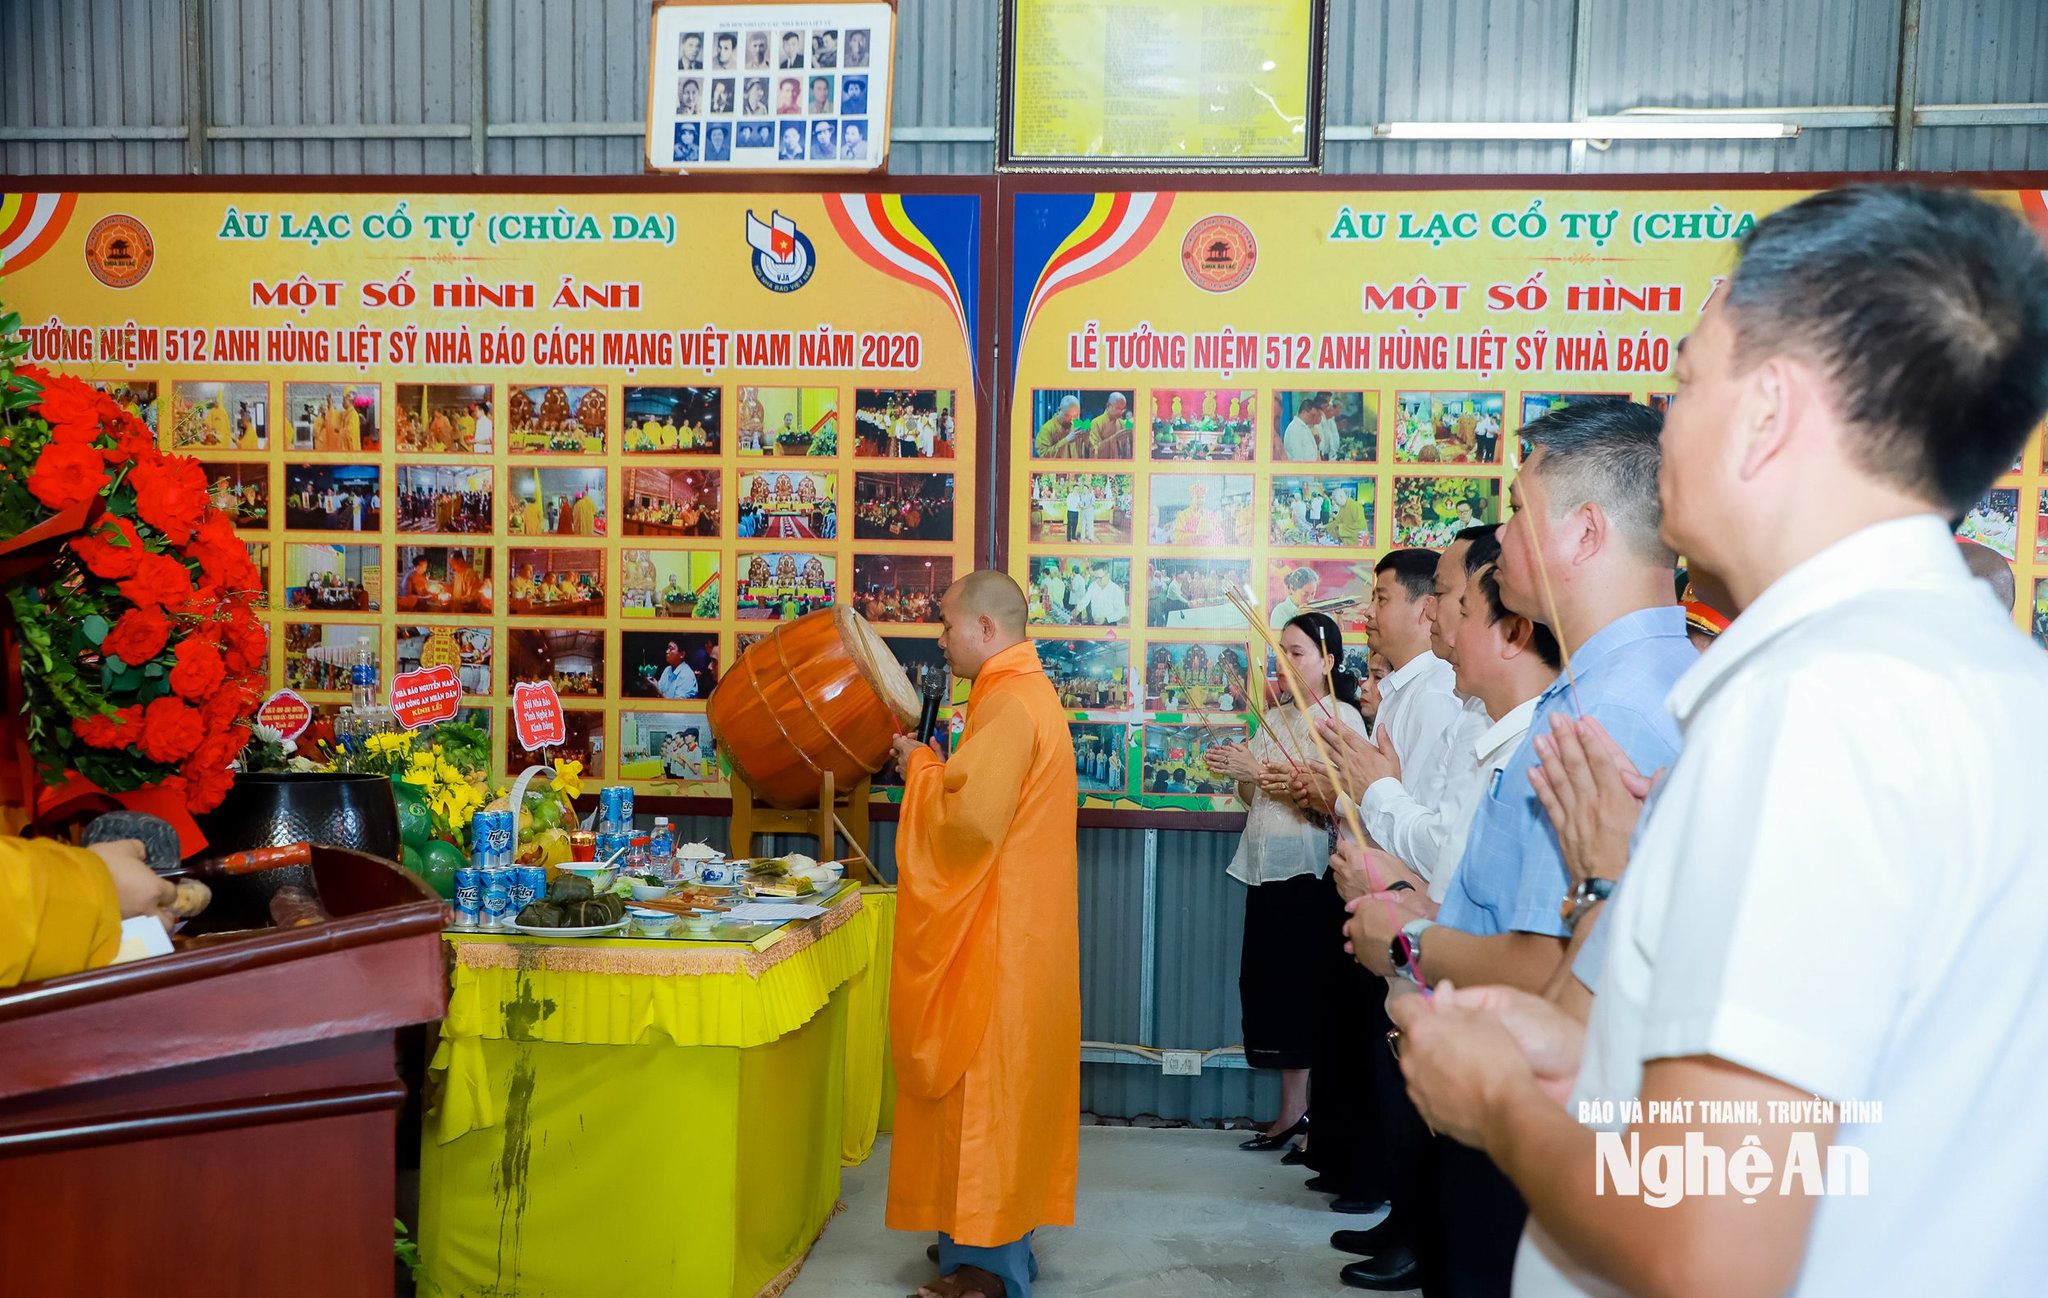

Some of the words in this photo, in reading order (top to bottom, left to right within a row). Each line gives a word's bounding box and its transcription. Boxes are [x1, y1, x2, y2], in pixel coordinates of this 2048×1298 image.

[220, 208, 269, 239] ÂU
[281, 213, 351, 246] LẠC
[362, 203, 413, 240] CỔ
[424, 211, 476, 247] TỰ
[488, 209, 602, 244] (CHÙA
[612, 214, 676, 244] DA)
[1330, 207, 1387, 240] ÂU
[1398, 213, 1478, 247] LẠC
[1490, 199, 1548, 240] CỔ
[1559, 210, 1619, 247] TỰ
[1633, 205, 1757, 245] (CHÙA
[254, 275, 343, 313] MỘT
[363, 271, 416, 307] SỐ
[434, 276, 534, 307] HÌNH
[553, 277, 640, 308] ẢNH
[1365, 278, 1467, 318] MỘT
[1488, 272, 1547, 310] SỐ
[1568, 279, 1681, 311] HÌNH
[19, 317, 93, 361] TƯỞNG
[101, 323, 158, 368] NIỆM
[166, 330, 206, 361] 512
[214, 329, 259, 362] ANH
[268, 323, 328, 363] HÙNG
[337, 325, 381, 370] LIỆT
[389, 326, 418, 363] SỸ
[425, 325, 472, 364] NHÀ
[480, 327, 526, 365] BÁO
[534, 326, 595, 365] CÁCH
[604, 333, 672, 373] MẠNG
[680, 327, 729, 373] VIỆT
[737, 334, 790, 366] NAM
[800, 327, 853, 367] NĂM
[862, 335, 919, 368] 2020
[1071, 323, 1097, 369] LỄ
[1105, 323, 1185, 369] TƯỞNG
[1195, 329, 1258, 376] NIỆM
[1266, 336, 1311, 369] 512
[1319, 336, 1370, 369] ANH
[1379, 329, 1447, 370] HÙNG
[1456, 329, 1508, 378] LIỆT
[1515, 331, 1547, 371] SỸ
[1556, 330, 1607, 371] NHÀ
[1617, 330, 1669, 372] BÁO
